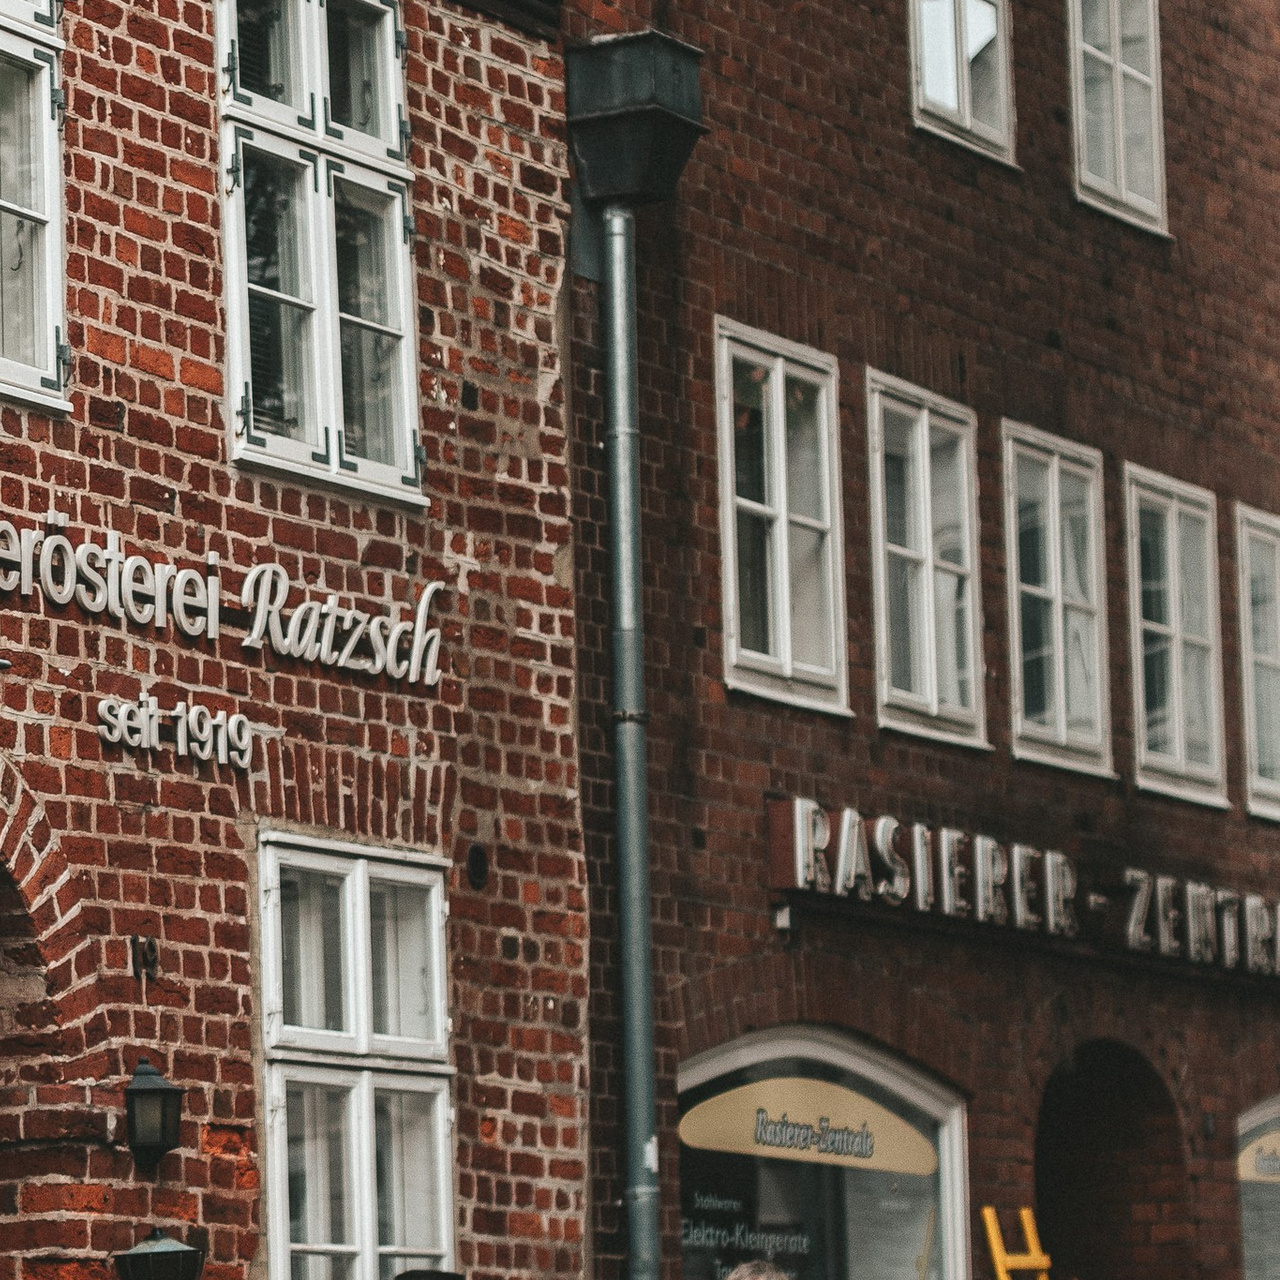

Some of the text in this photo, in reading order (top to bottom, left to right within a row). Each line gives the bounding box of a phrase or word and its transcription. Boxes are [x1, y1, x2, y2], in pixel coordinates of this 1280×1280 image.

[241, 561, 446, 687] Ratzsch
[97, 691, 253, 770] seit 1919
[794, 797, 1280, 977] RASIERER-ZENTR
